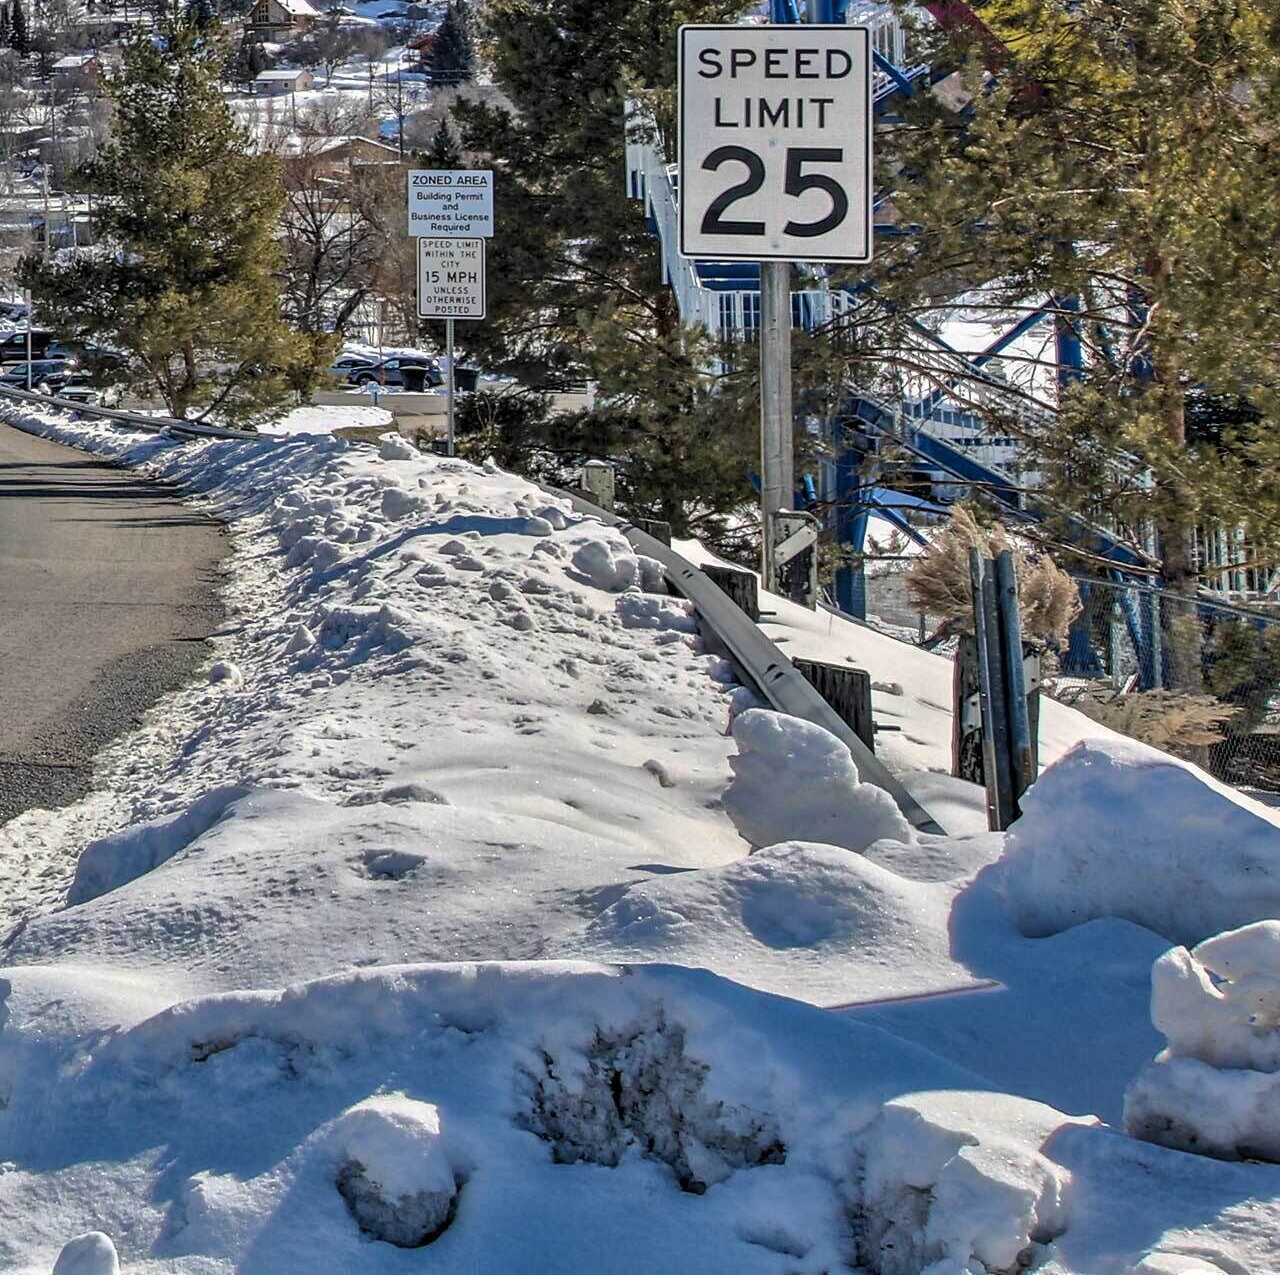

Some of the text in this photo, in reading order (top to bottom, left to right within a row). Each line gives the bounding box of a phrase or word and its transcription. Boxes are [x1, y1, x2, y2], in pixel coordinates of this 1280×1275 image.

[697, 48, 853, 79] SPEED
[714, 97, 835, 129] LIMIT
[412, 175, 488, 185] ZONED AREA
[700, 144, 849, 238] 25
[416, 191, 483, 202] Building Permit
[411, 212, 489, 221] Business License
[431, 222, 471, 231] Required
[422, 240, 479, 249] SPEED LIMIT
[425, 250, 454, 258] WITHIN
[441, 260, 460, 268] CITY
[426, 271, 477, 284] 15 MPH
[434, 286, 469, 295] UNLESS
[426, 295, 477, 305] OTHERWISE
[435, 306, 470, 314] POSTED
